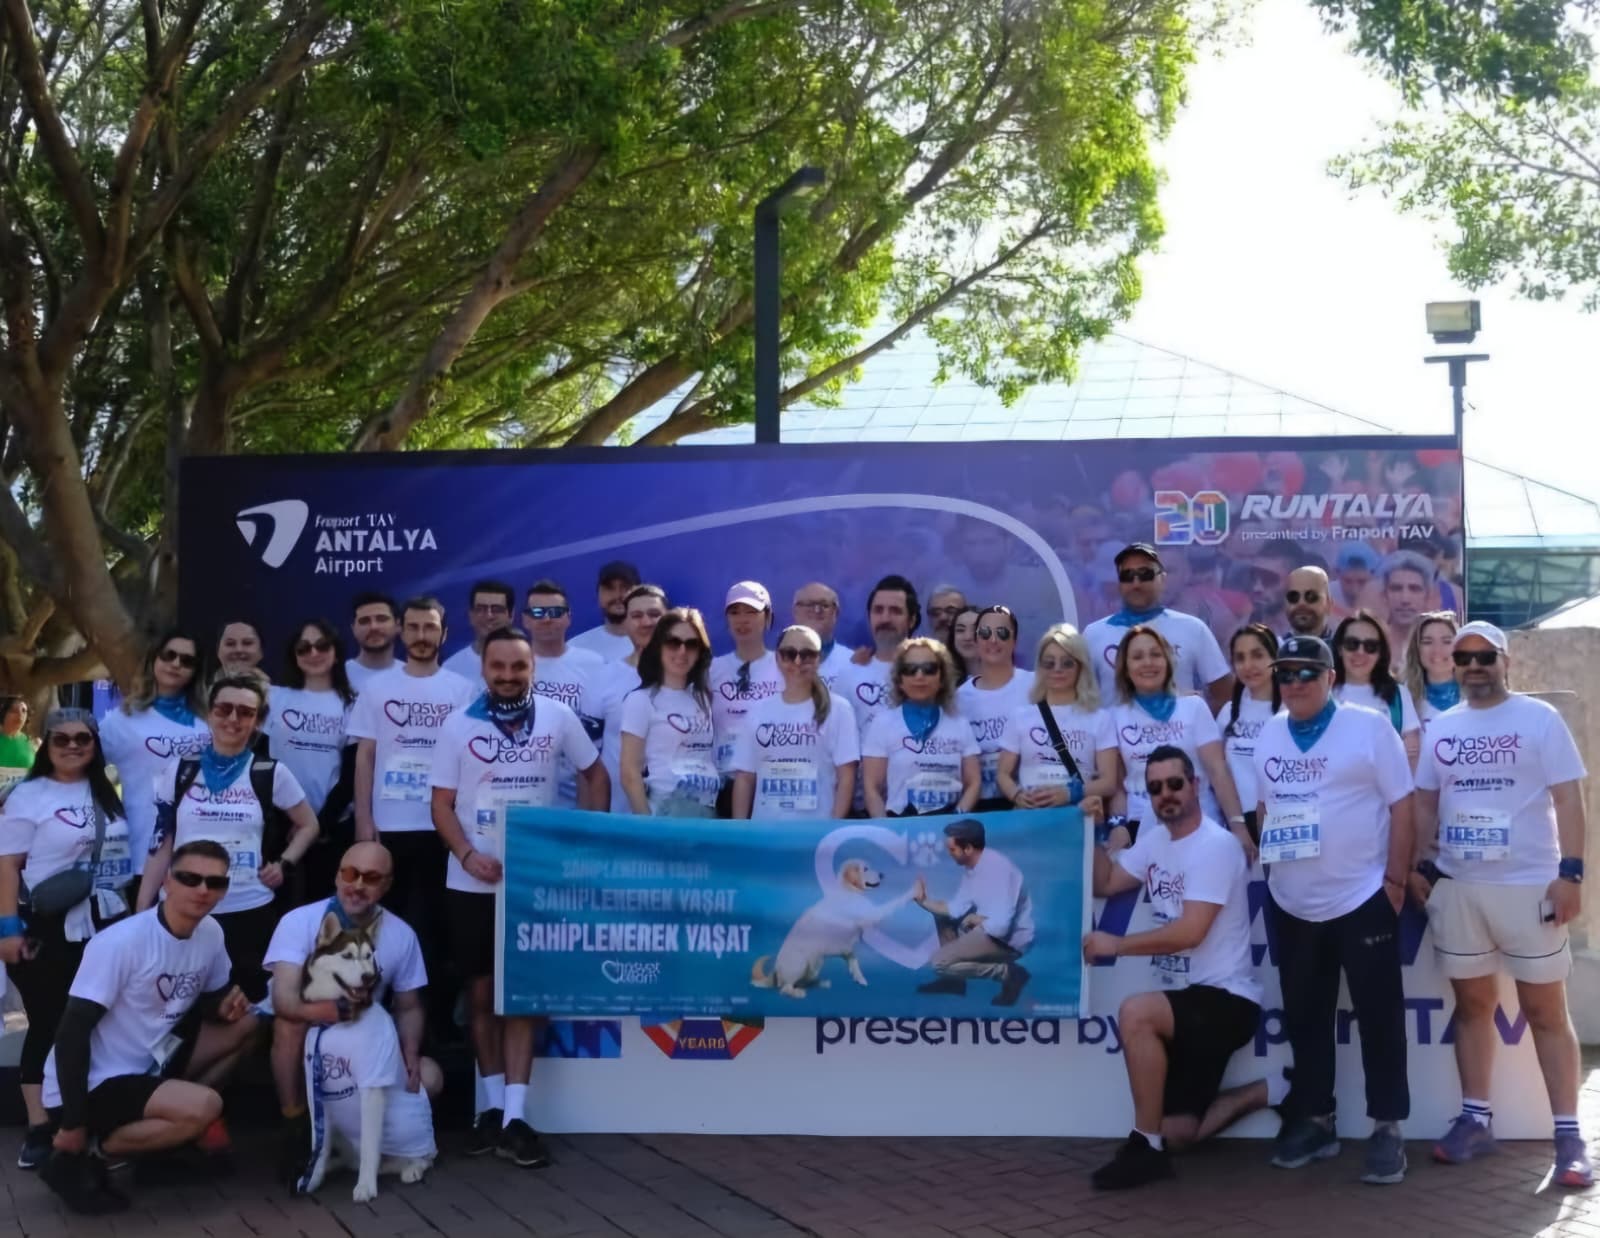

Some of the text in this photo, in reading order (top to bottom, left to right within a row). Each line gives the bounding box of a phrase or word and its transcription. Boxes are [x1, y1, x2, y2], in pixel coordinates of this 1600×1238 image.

[1154, 490, 1230, 545] 20
[1240, 493, 1434, 520] RUNTALYA
[315, 528, 438, 552] ANTALYA
[1242, 525, 1435, 542] presented by Fraport TAV
[315, 556, 383, 577] Airport
[1457, 748, 1516, 766] team
[680, 888, 737, 915] YAŞAT
[517, 917, 752, 959] SAHİPLENEREK YAŞAT
